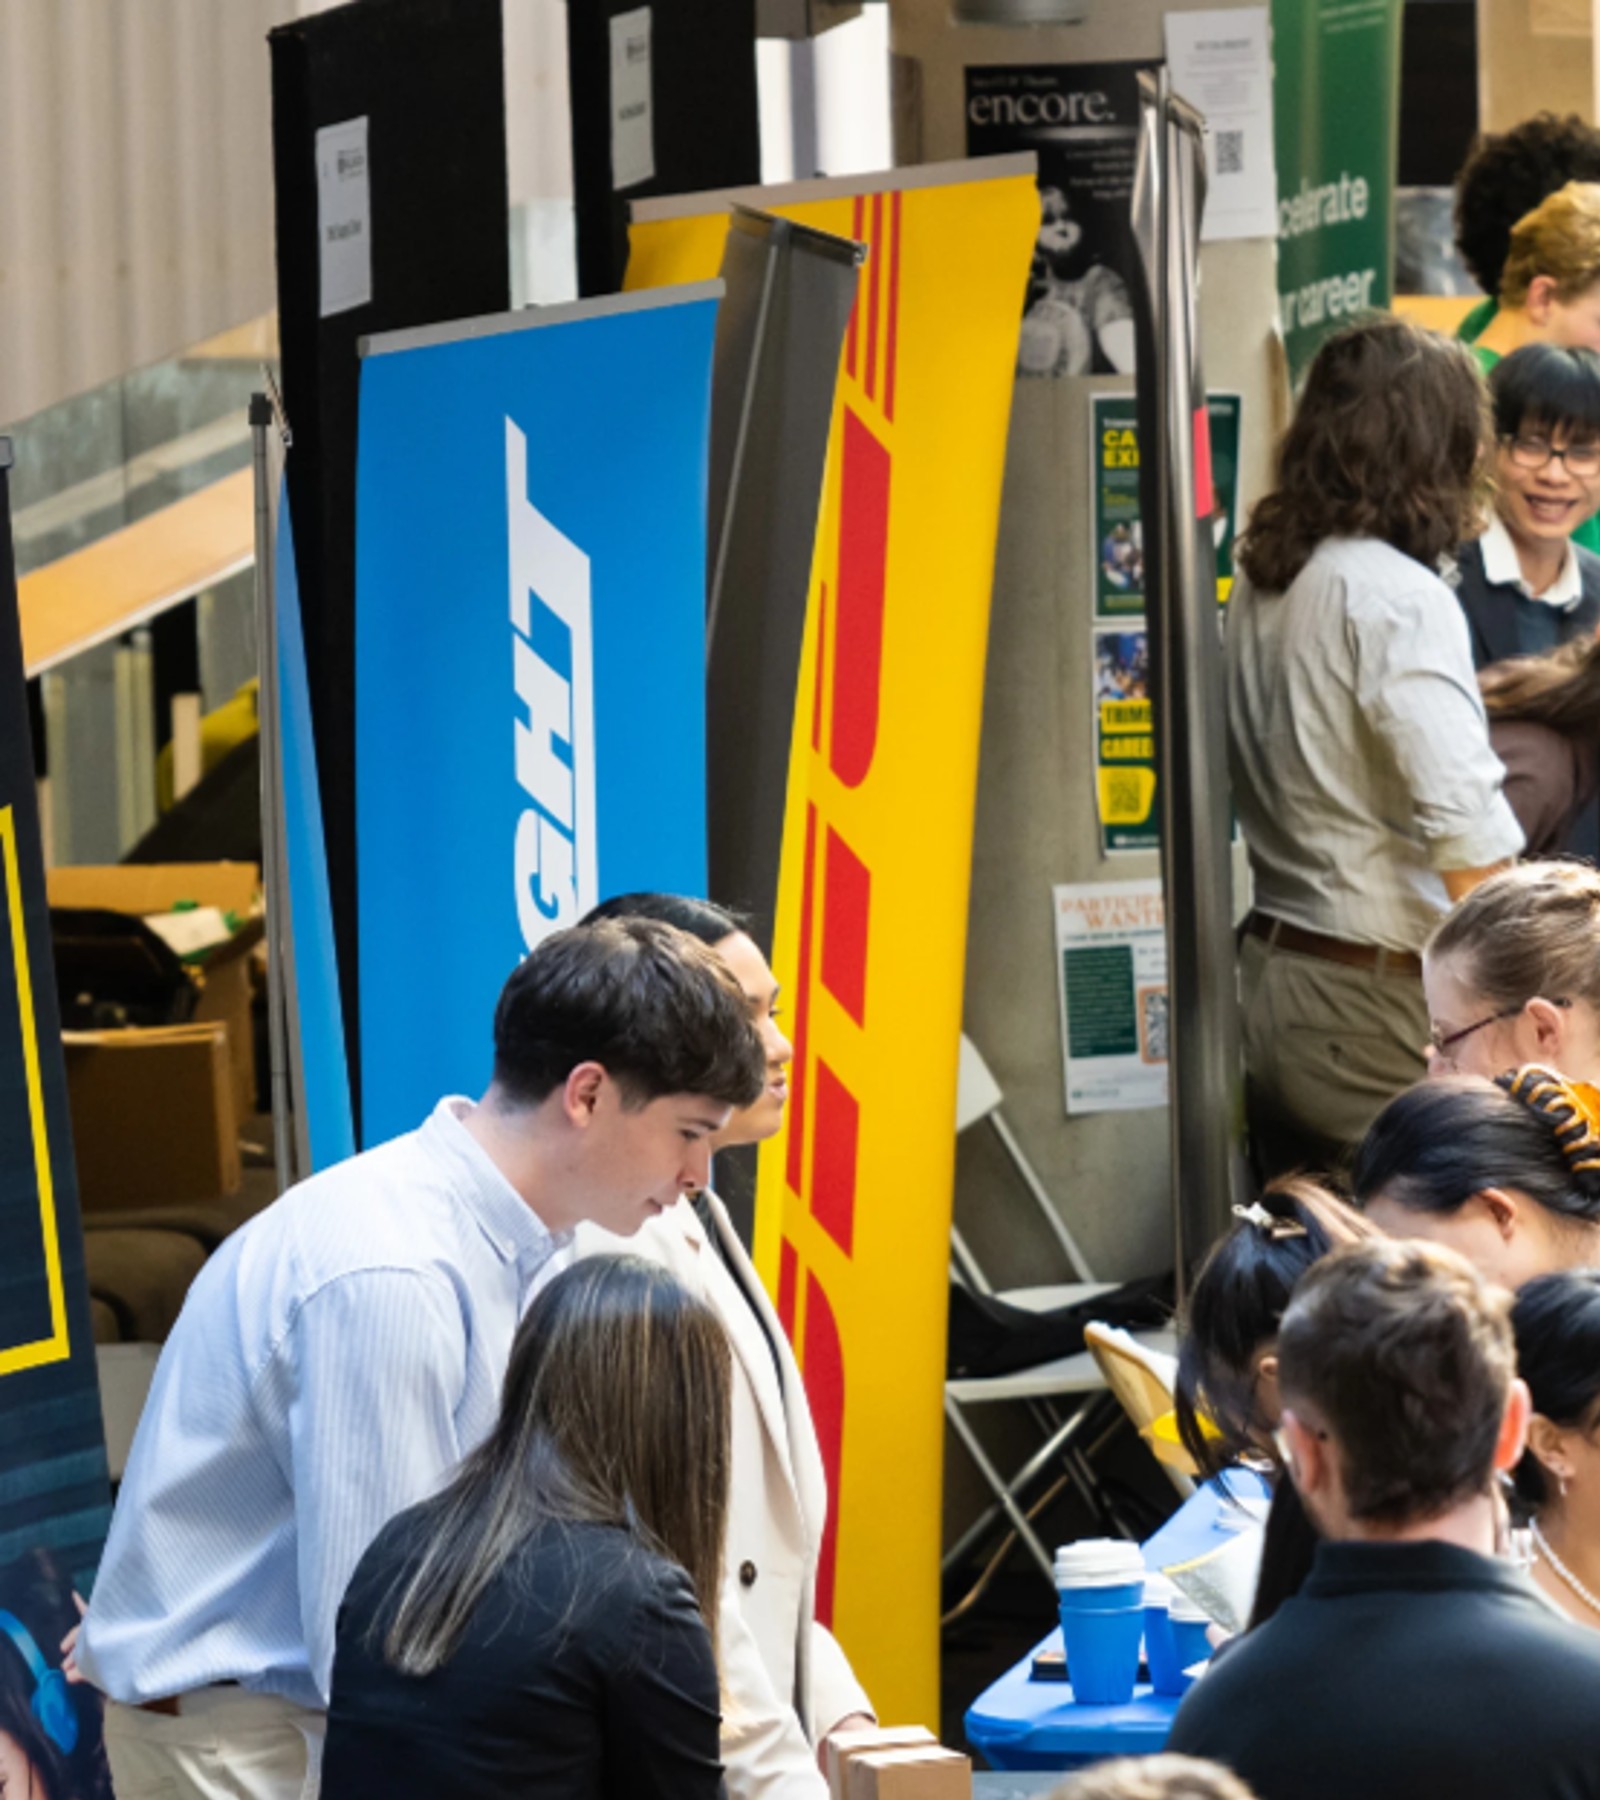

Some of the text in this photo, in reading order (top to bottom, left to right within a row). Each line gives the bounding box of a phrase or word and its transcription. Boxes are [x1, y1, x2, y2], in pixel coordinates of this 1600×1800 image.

[970, 92, 1116, 125] encore.
[1279, 169, 1368, 240] celerate
[1297, 268, 1376, 328] career
[505, 413, 598, 960] GHT
[1061, 893, 1163, 913] PARTICIP
